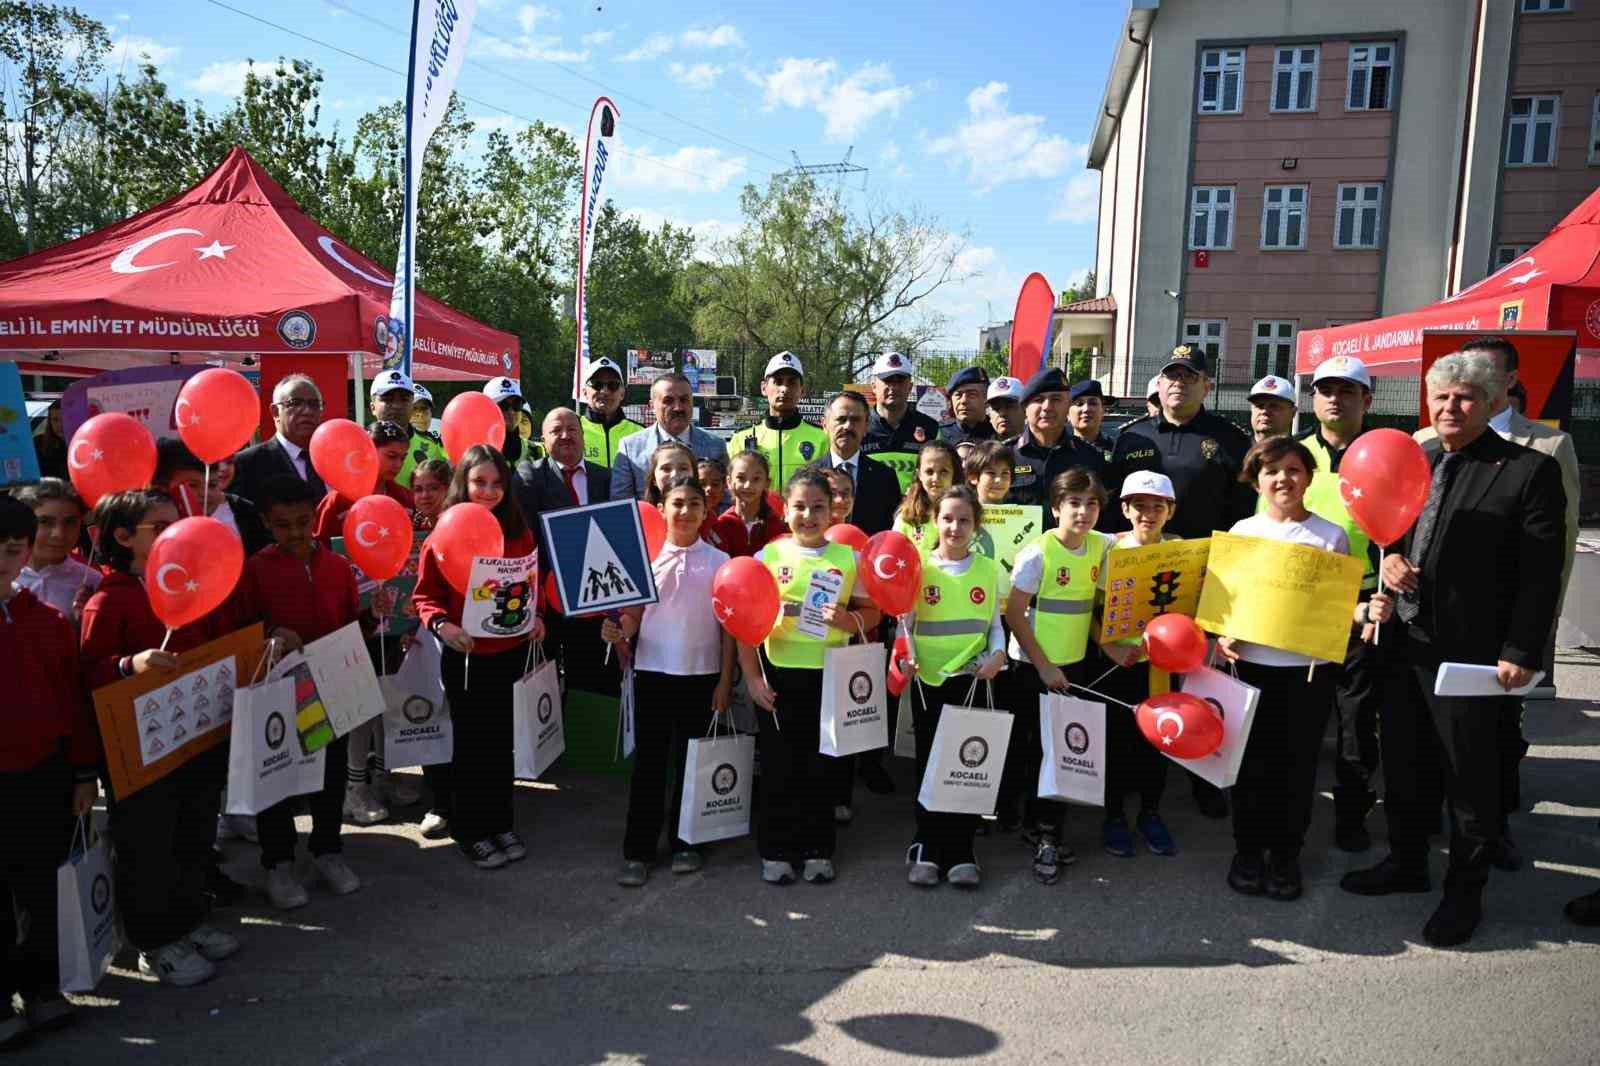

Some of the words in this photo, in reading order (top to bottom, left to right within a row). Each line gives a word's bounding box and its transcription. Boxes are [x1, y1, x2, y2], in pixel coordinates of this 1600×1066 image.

[29, 317, 47, 335] İL
[51, 315, 134, 335] EMNİYET
[139, 317, 259, 337] MÜDÜRLÜĞÜ
[1371, 329, 1415, 352] JANDARMA
[847, 705, 877, 718] KOCAELİ
[400, 725, 440, 737] KOCAELİ
[1062, 756, 1095, 768] KOCAELİ
[949, 770, 988, 780] KOCAELİ
[706, 796, 740, 809] KOCAELİ
